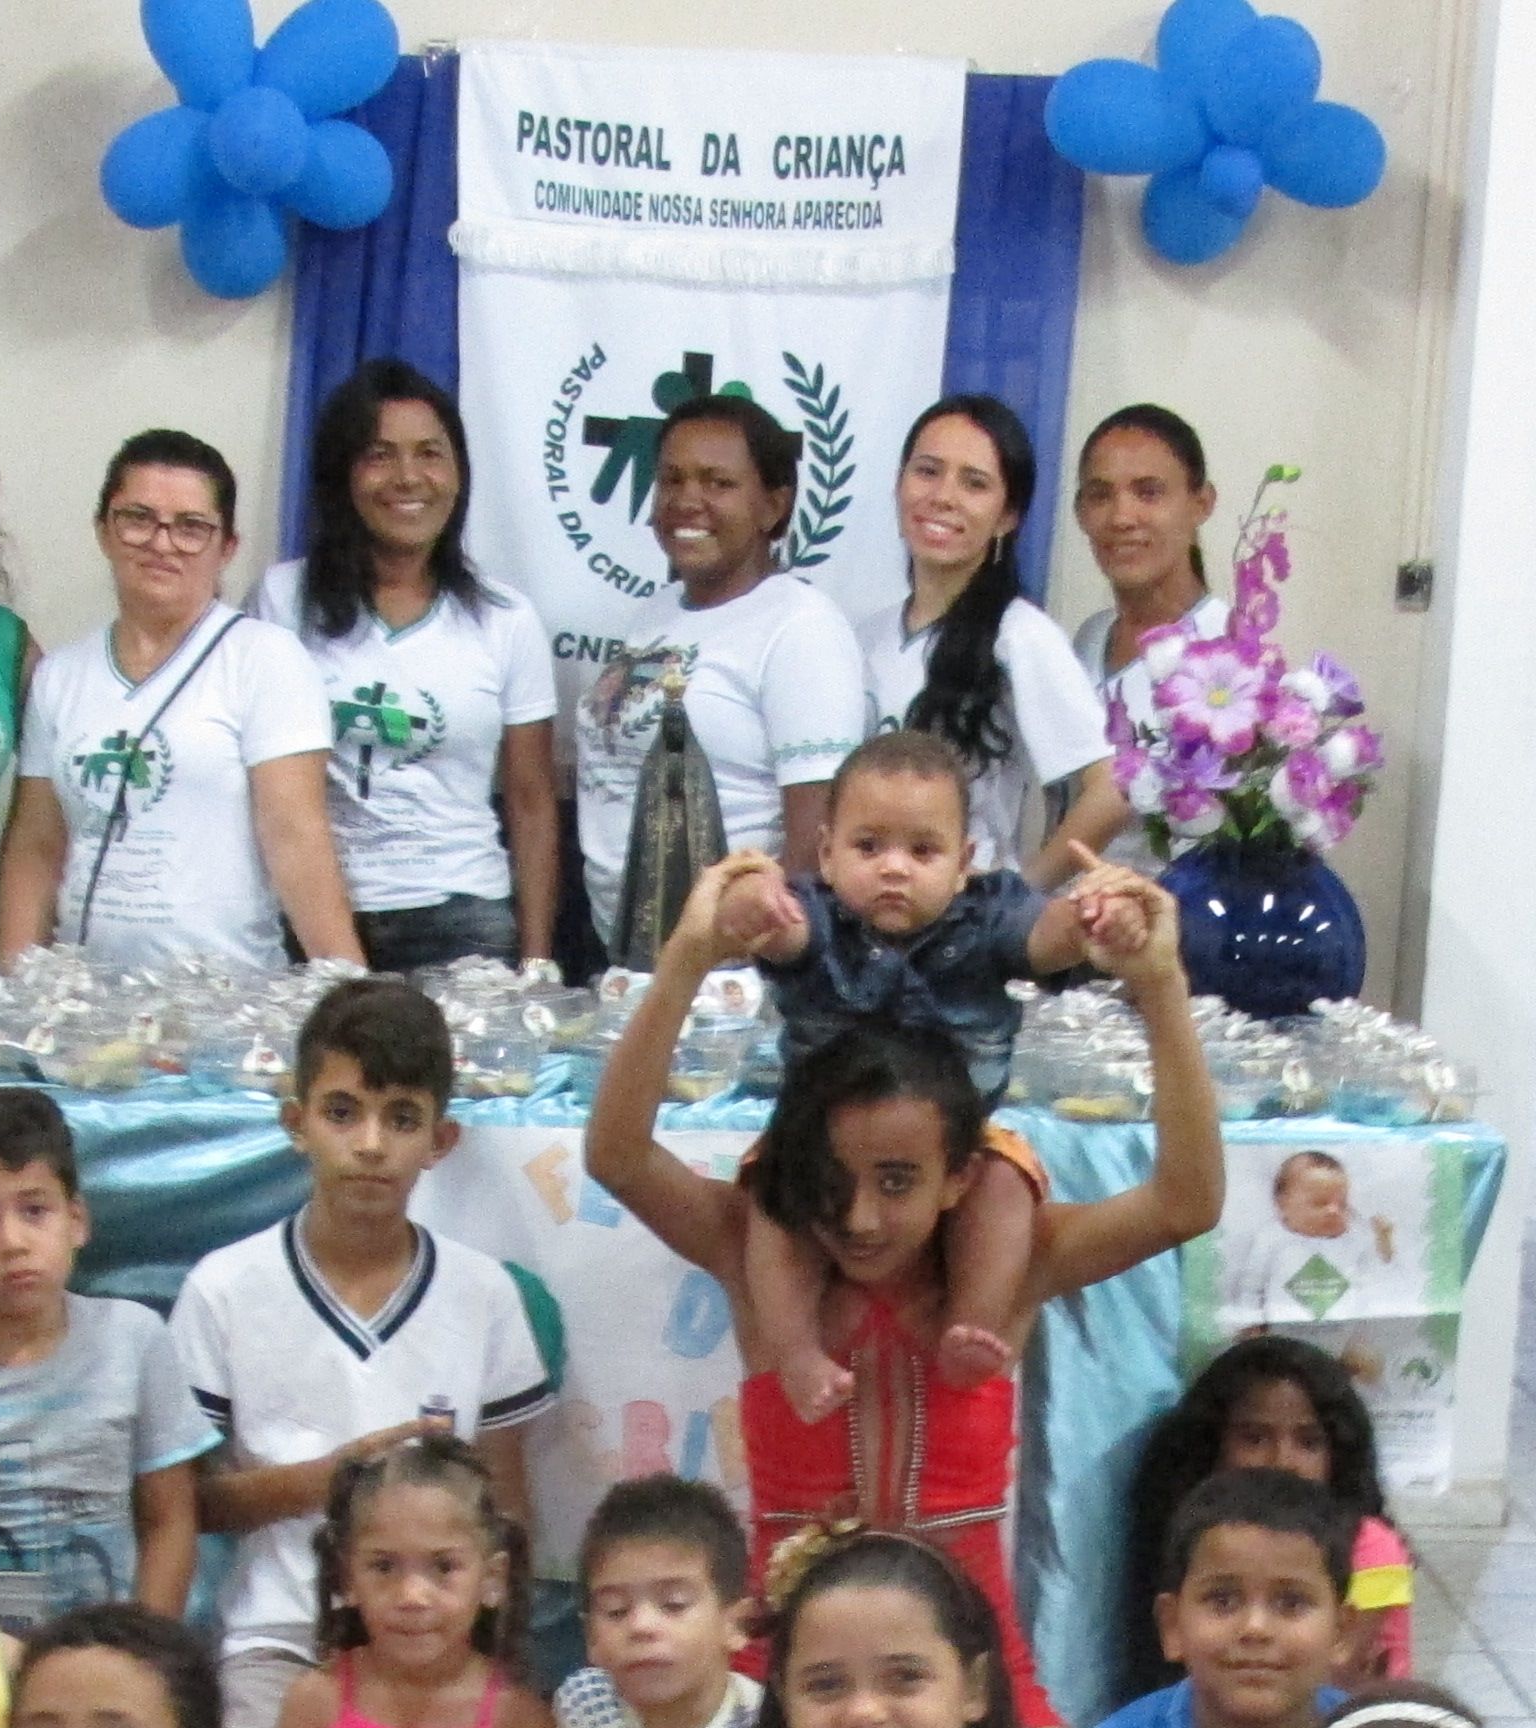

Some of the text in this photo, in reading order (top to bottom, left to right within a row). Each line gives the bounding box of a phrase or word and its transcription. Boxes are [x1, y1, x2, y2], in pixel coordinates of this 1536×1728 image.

[517, 110, 906, 191] PASTORAL DA CRIANÇA
[534, 178, 883, 231] COMUNIDADE NOSSA SENHORA APARECIDA
[542, 341, 669, 599] PASTORAL DA CRIA
